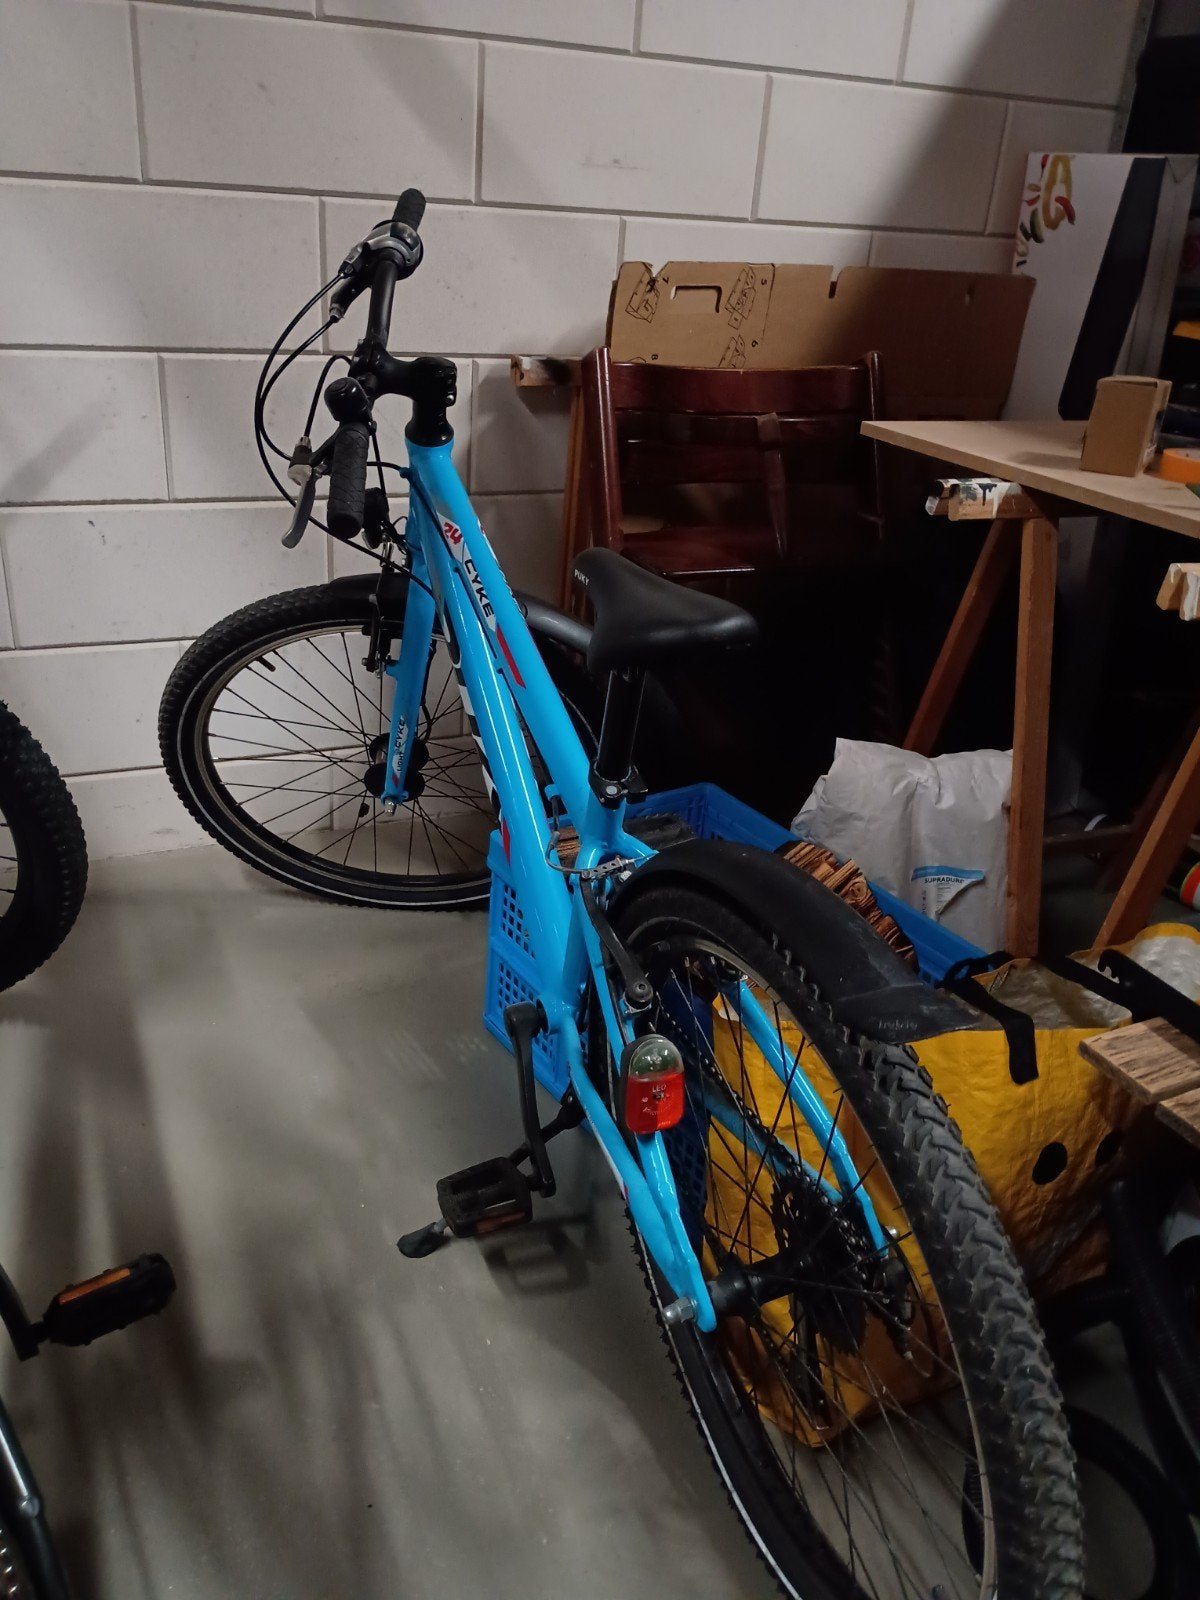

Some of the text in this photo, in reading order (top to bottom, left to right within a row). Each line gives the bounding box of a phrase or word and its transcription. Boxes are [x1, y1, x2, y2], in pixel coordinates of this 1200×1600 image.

[662, 276, 670, 284] 7
[760, 278, 768, 286] 5
[751, 339, 759, 348] 6
[651, 353, 659, 361] 8
[444, 522, 464, 545] 24
[574, 569, 589, 586] PUKY
[464, 559, 495, 618] CYKE
